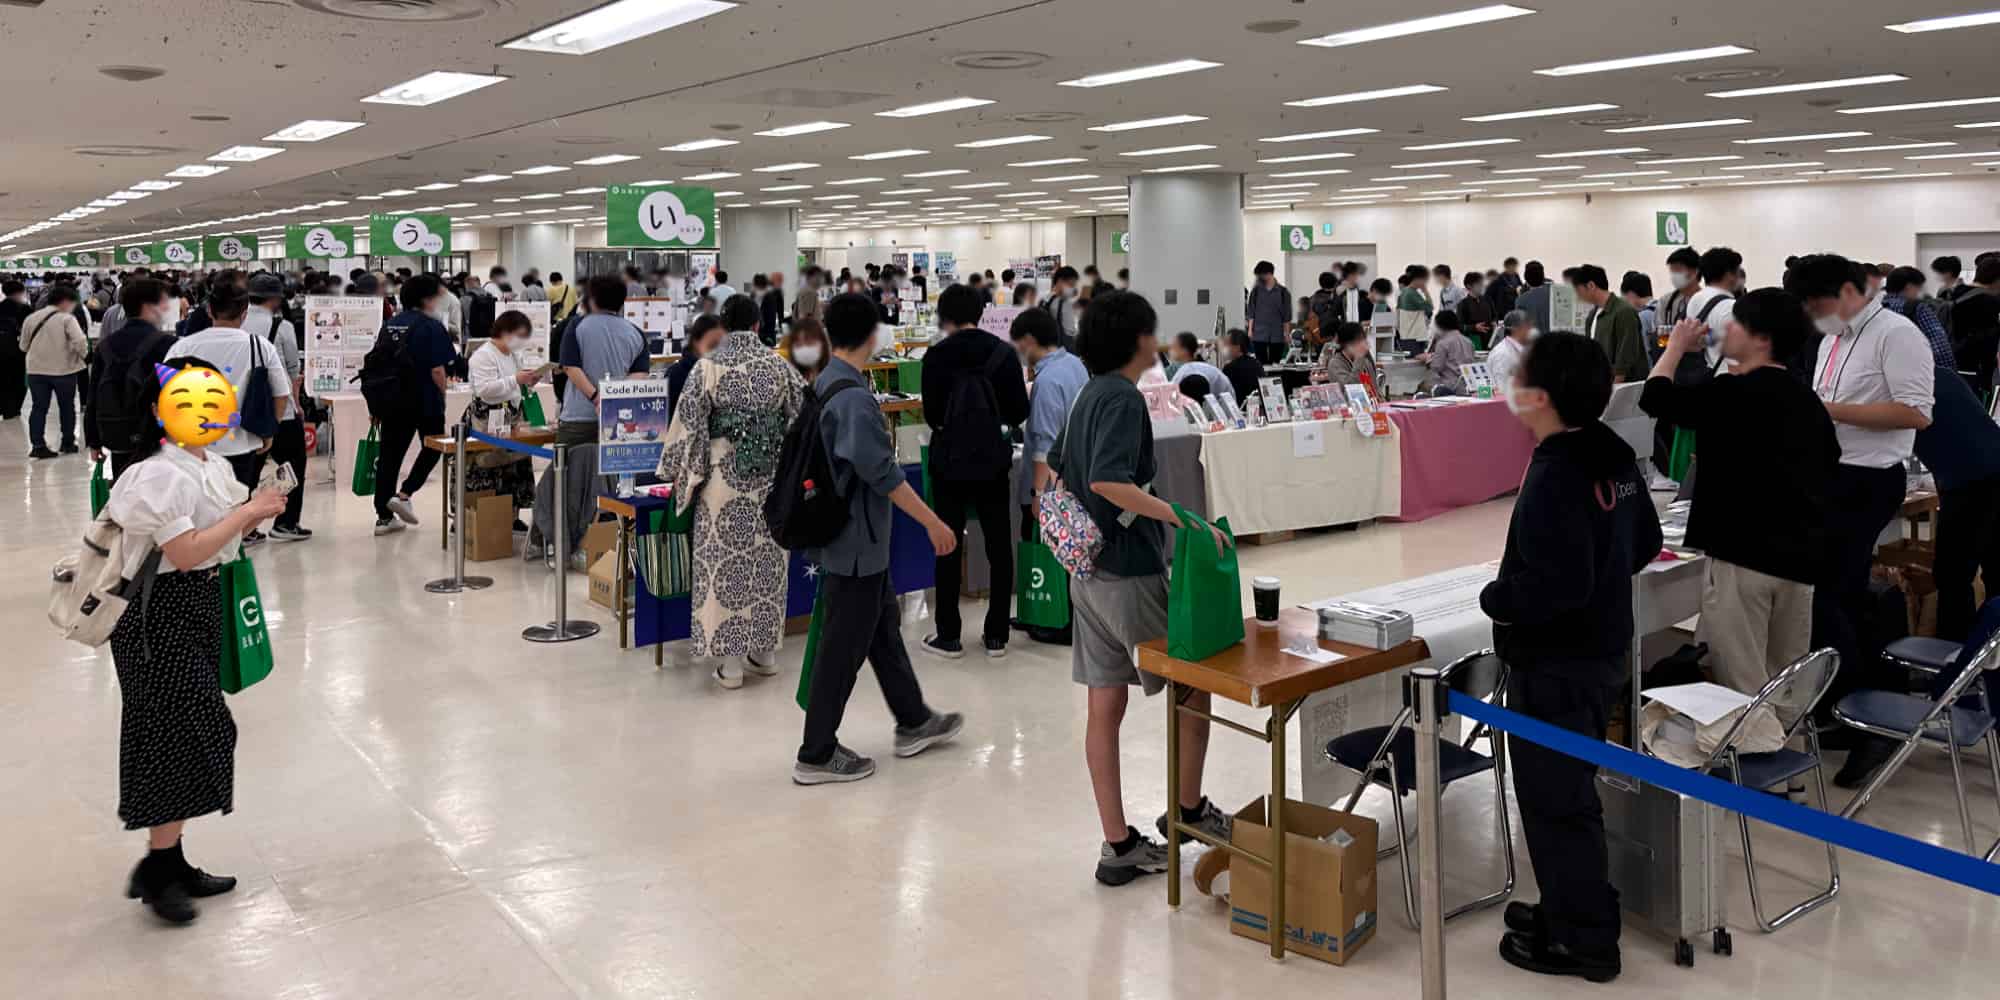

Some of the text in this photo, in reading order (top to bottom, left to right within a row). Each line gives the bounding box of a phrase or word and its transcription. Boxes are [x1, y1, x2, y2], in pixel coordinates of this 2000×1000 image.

[649, 203, 677, 230] い
[311, 232, 329, 250] え
[402, 223, 419, 246] う
[169, 246, 183, 258] か
[223, 240, 238, 256] お
[605, 383, 664, 394] Code Polaris
